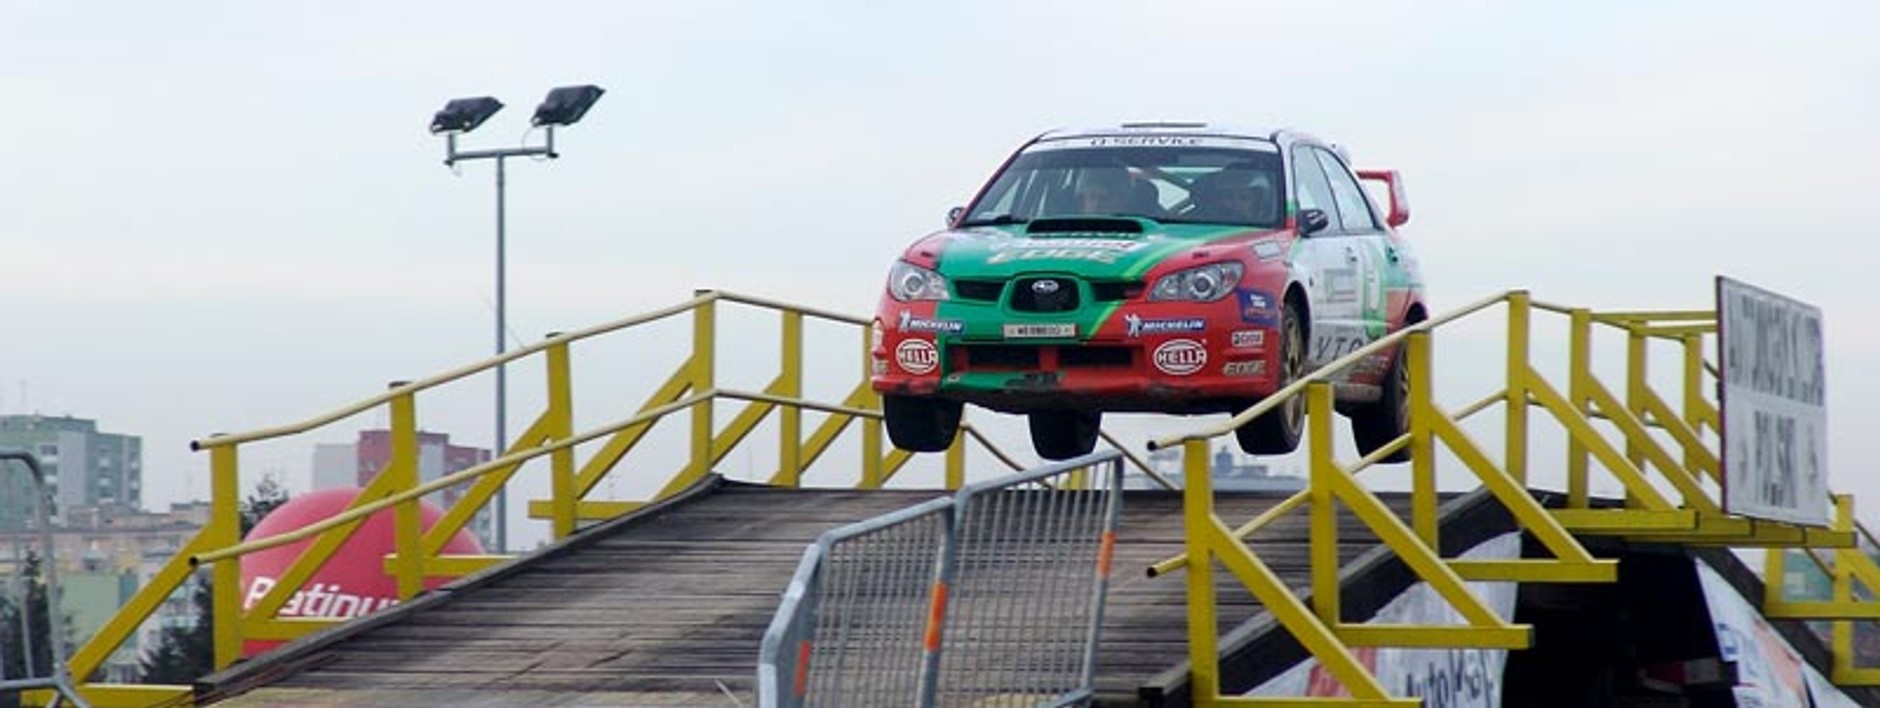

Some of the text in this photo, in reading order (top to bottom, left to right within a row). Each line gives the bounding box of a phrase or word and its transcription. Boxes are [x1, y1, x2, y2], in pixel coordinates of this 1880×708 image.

[910, 317, 963, 332] MICHELIN
[1143, 319, 1205, 332] MICHELIN
[899, 346, 938, 364] HELLA
[1157, 348, 1206, 365] HELLA
[1223, 360, 1267, 376] EDGE
[242, 576, 402, 618] Patinu
